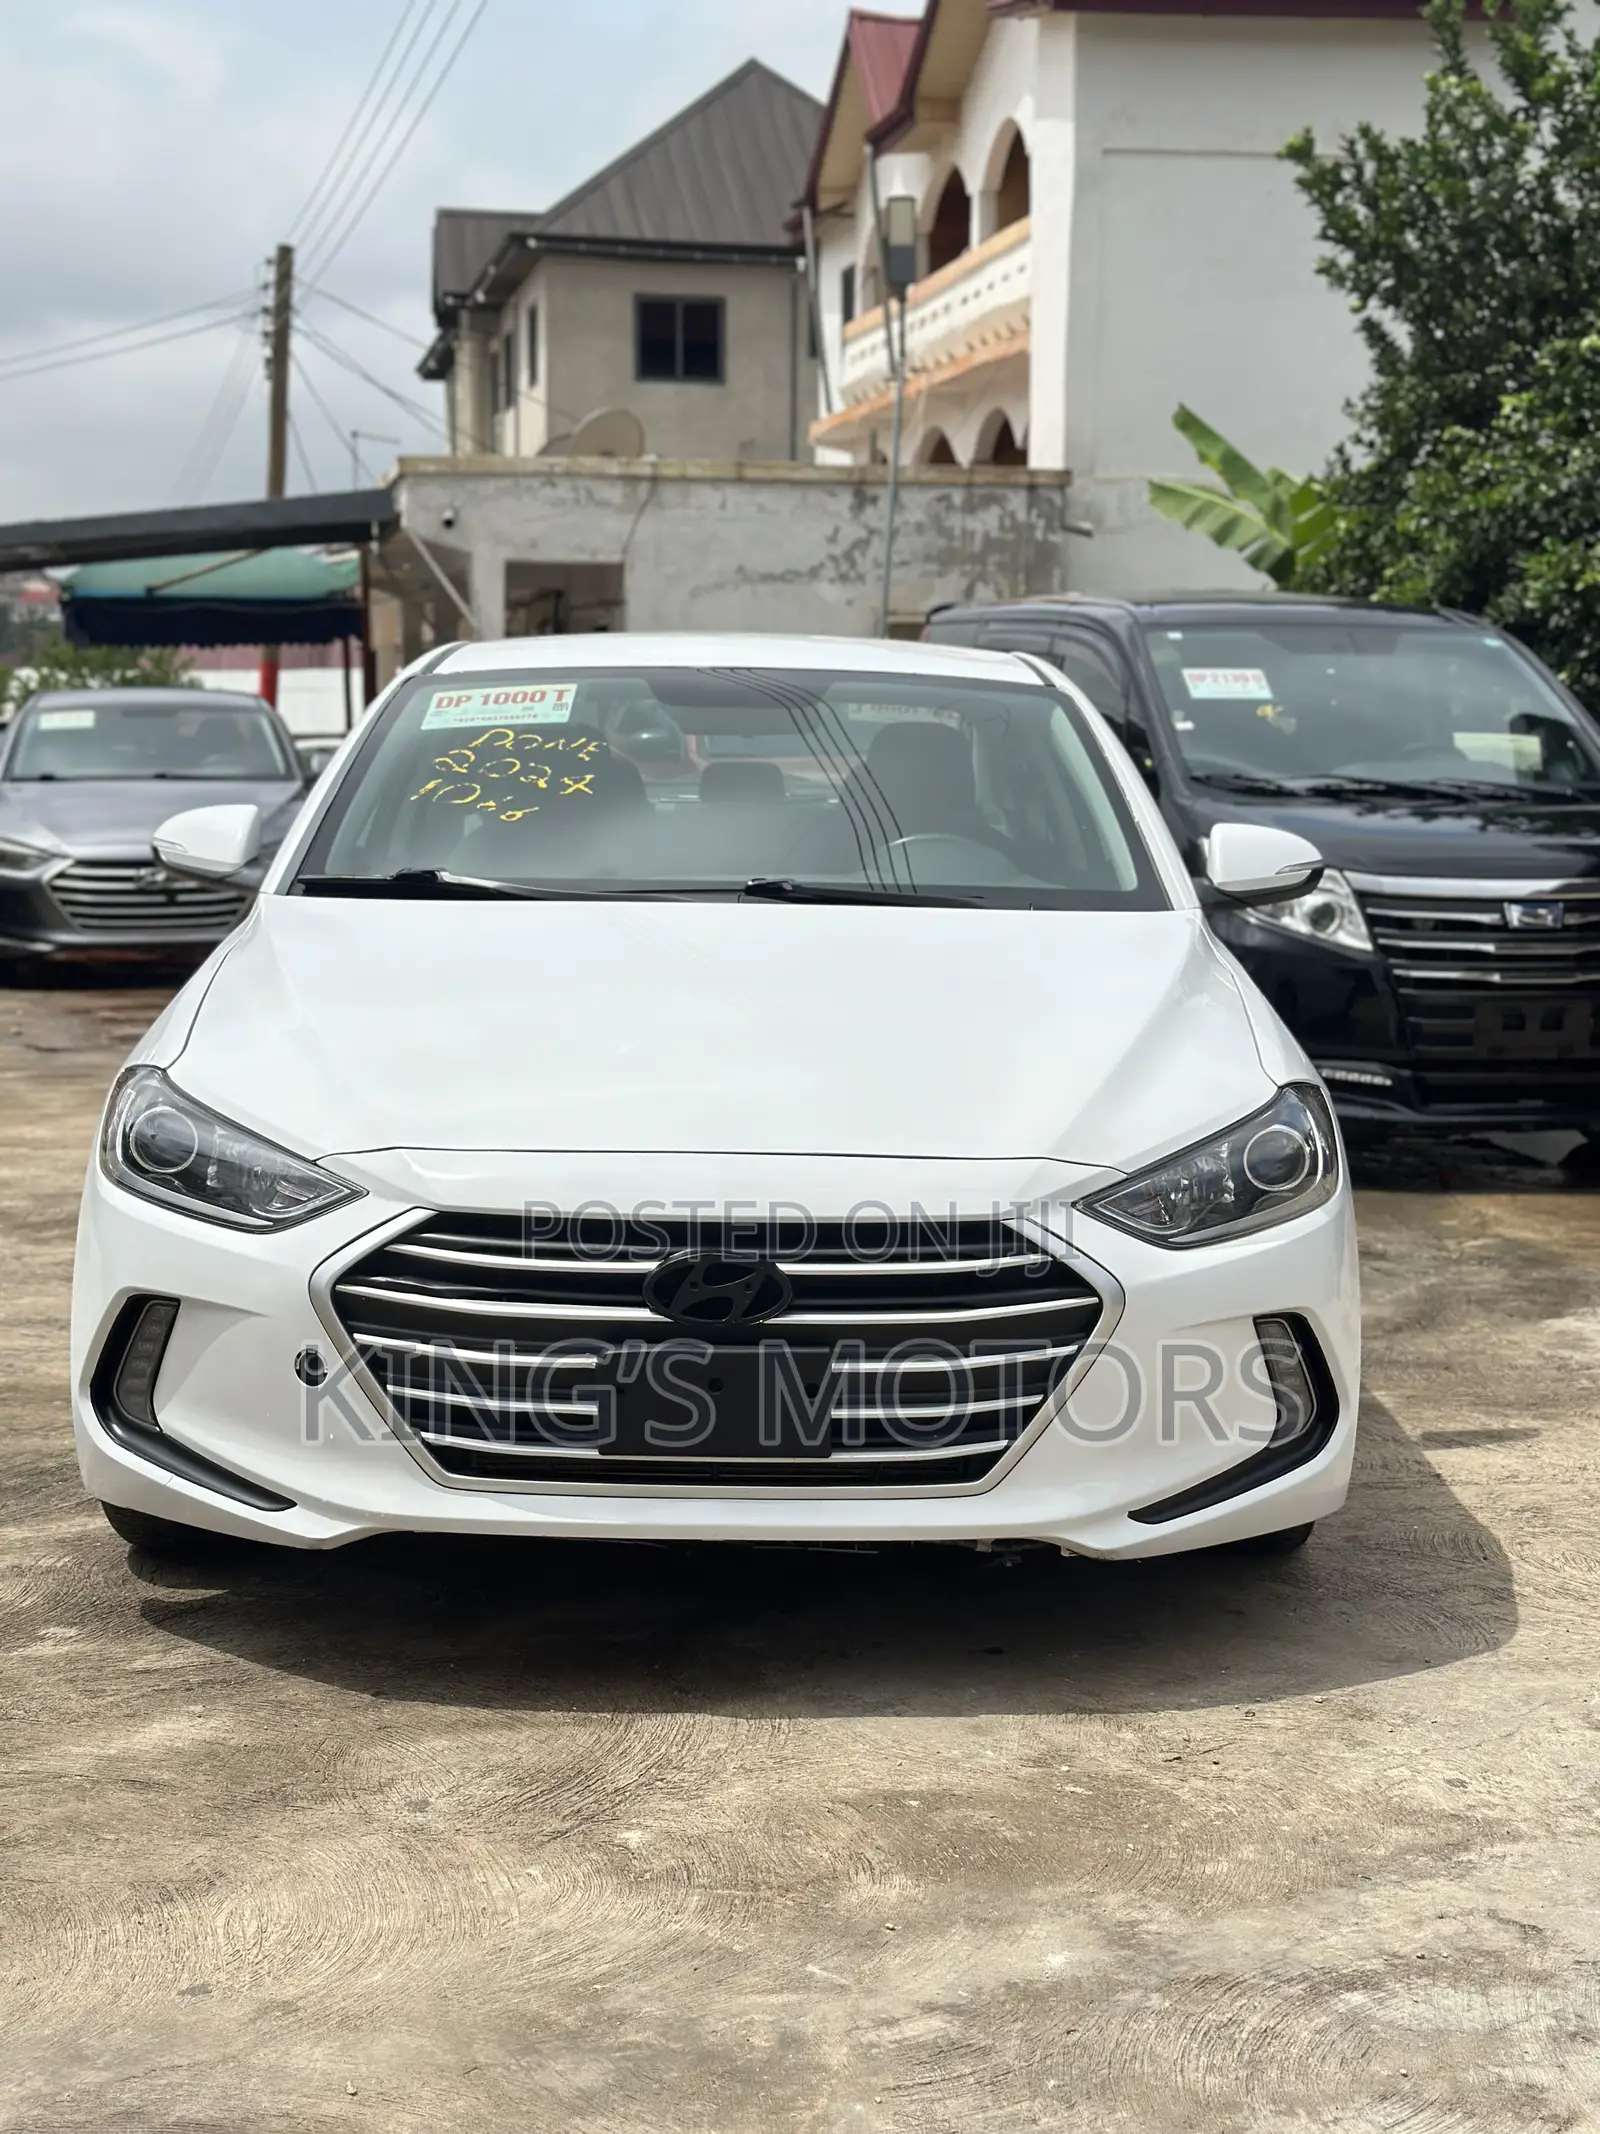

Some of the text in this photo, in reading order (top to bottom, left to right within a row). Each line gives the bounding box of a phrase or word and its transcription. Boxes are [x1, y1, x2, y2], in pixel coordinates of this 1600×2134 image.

[434, 688, 572, 710] DP 1000 T
